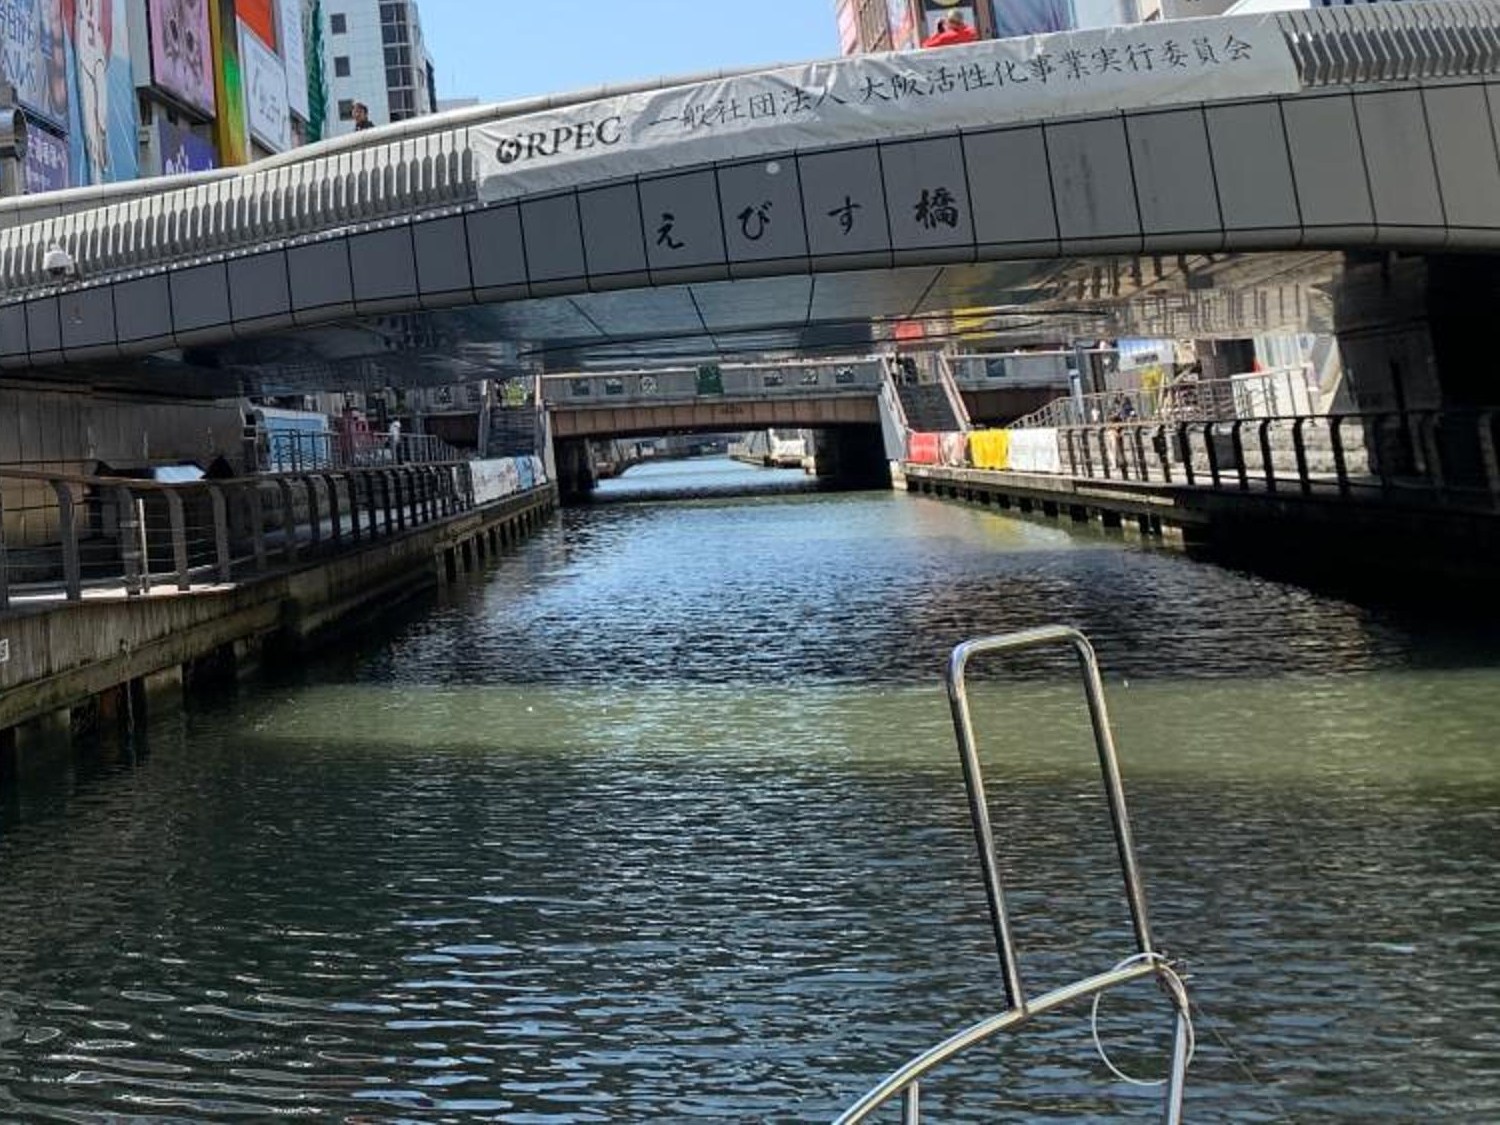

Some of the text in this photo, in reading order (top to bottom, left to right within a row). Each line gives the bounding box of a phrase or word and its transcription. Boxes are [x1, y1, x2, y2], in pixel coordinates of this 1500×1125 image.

[648, 86, 846, 131] 一般社団法人
[859, 33, 1252, 104] 大阪活性化事業実行委員会
[655, 185, 960, 251] えびす橋
